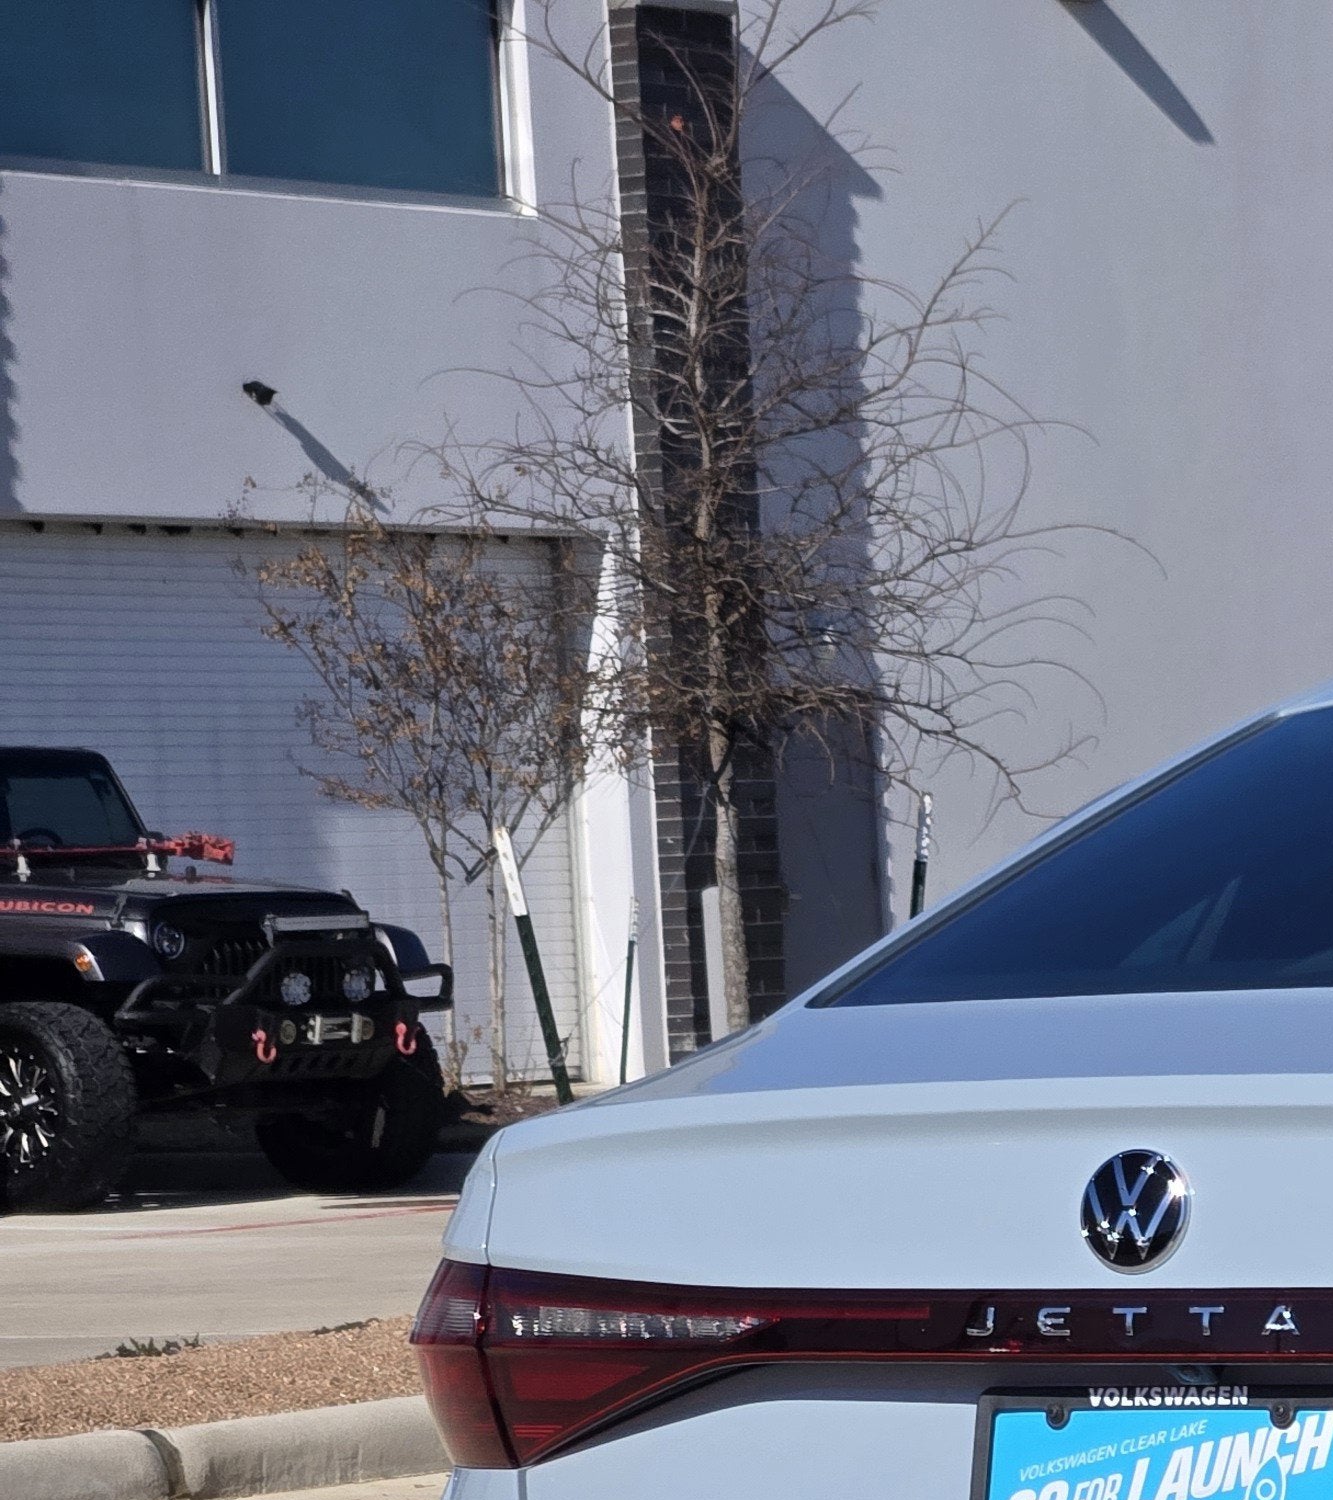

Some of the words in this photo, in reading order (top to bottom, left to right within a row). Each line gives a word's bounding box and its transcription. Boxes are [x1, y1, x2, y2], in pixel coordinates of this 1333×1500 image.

[0, 900, 94, 914] UBICON
[966, 1305, 1301, 1336] JETTA
[1088, 1385, 1248, 1408] VOLKSWAGEN
[1018, 1443, 1119, 1483] VOLKSWAGEN
[1119, 1430, 1166, 1456] CLEAR
[1169, 1418, 1210, 1442] LAKE
